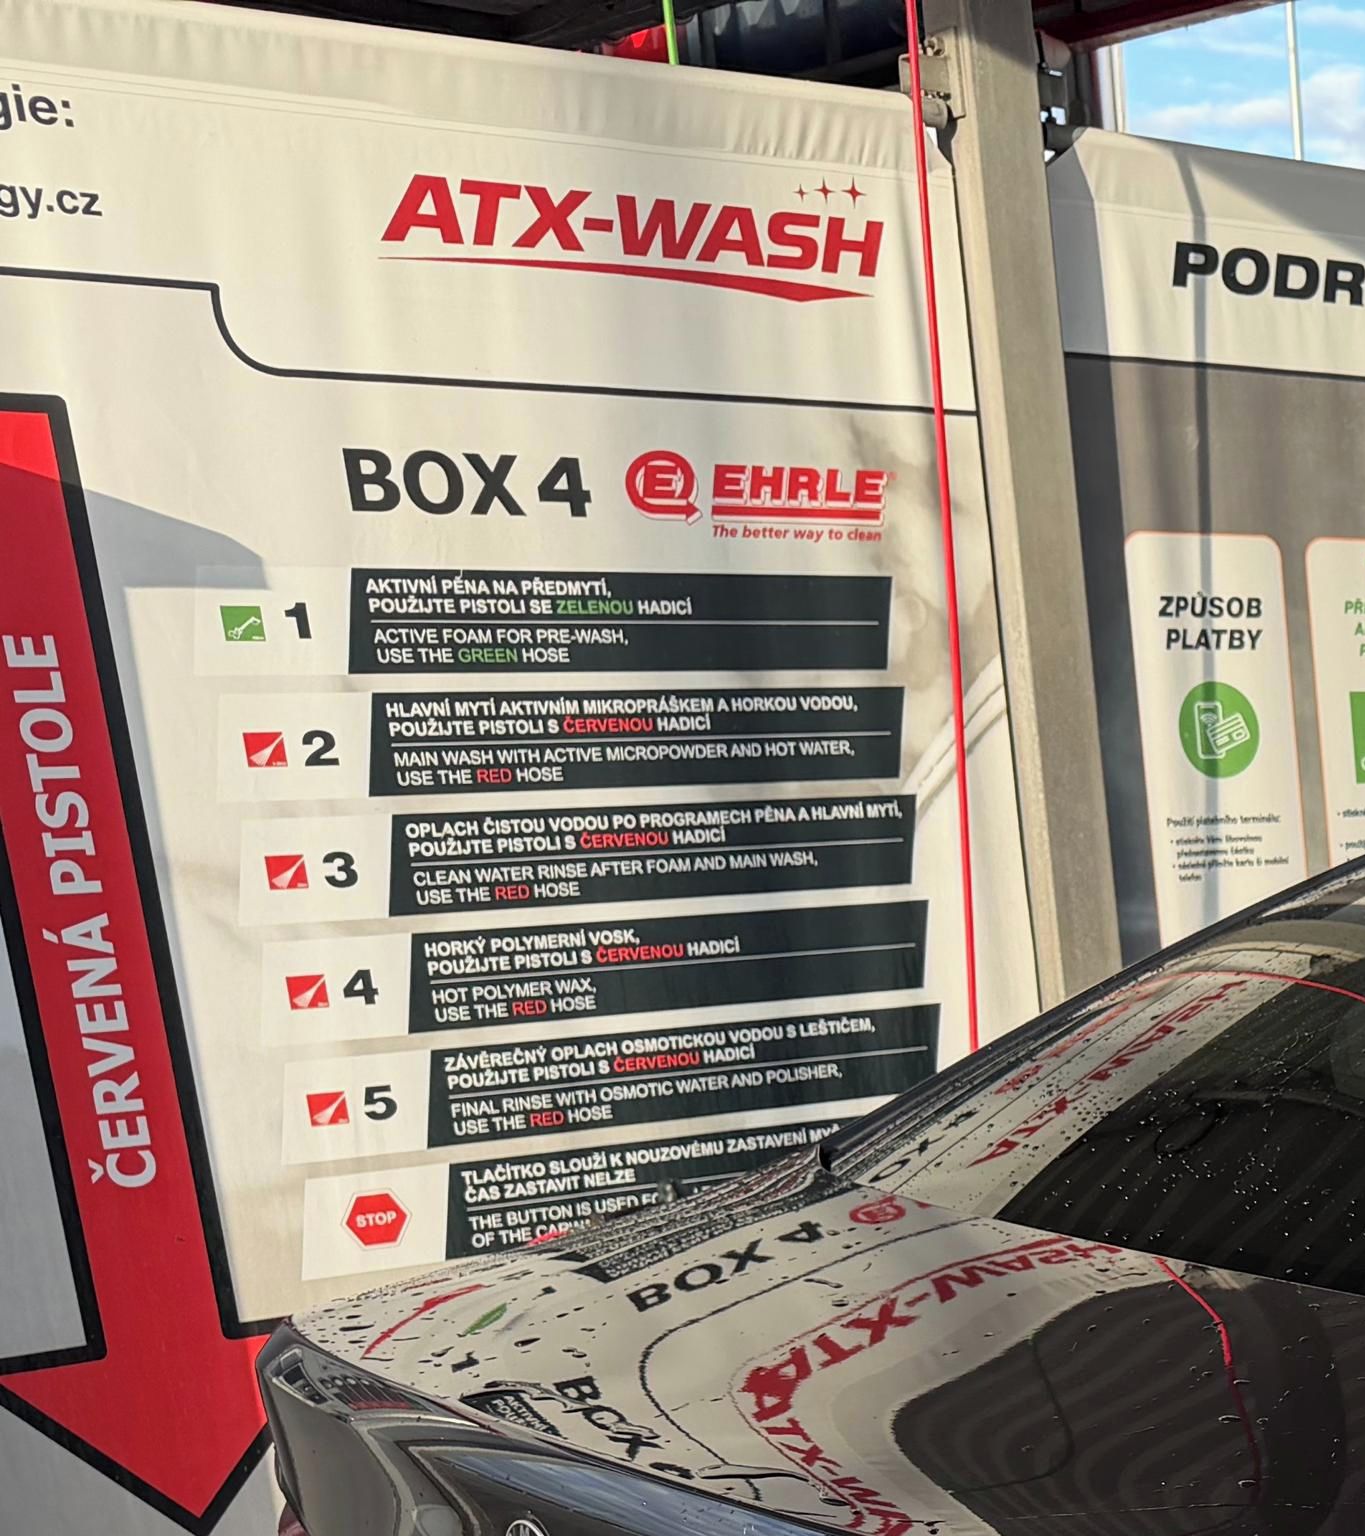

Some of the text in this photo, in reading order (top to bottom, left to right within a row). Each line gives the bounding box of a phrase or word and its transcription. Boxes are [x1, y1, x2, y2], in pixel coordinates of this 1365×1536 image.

[381, 174, 884, 278] ATX-WASH
[342, 448, 592, 517] BOX 4
[712, 464, 888, 508] EHRLE
[712, 524, 881, 542] The better way to clean
[366, 576, 611, 598] AKTIVNÍ PĚNA NA PŘEDMYTÍ,
[369, 595, 692, 615] POUŽIJTE PISTOLI SE ZELENOU HADICÍ
[1158, 591, 1262, 618] ZPŮSOB
[284, 602, 312, 640] 1
[374, 629, 629, 646] ACTIVE FOAM FOR PRE-WASH,
[1166, 629, 1263, 650] PLATBY
[377, 649, 570, 663] USE THE GREEN HOSE
[386, 695, 858, 717] HLAVNÍ MYTÍ AKTIVNÍM MIKROPRÁŠKEM HORKOU VODOU,
[389, 714, 710, 736] POUŽIJTE PISTOLI ČERVENOU HADICÍ
[302, 730, 340, 766] 2
[394, 740, 854, 767] MAIN WASH WITH ACTIVE MICROPOWDER AND HOT WATER,
[397, 767, 563, 786] USE THE RED HOSE
[406, 800, 902, 838] OPLACH ČISTOU VODOU PO PROGRAMECH PĚNA HLAVNÍ MYTÍ,
[322, 852, 358, 888] 3
[414, 851, 818, 886] CLEAN WATER RINSE AFTER FOAM AND MAIN WASH,
[3, 635, 157, 1189] ČERVENÁ PISTOLE
[425, 928, 639, 957] HORKÝ POLYMERNÍ VOSK,
[428, 936, 740, 976] POUŽIJTE PISTOLI ČERVENOU HADICÍ
[343, 969, 379, 1005] 4
[432, 978, 596, 1004] HOT POLYMER WAX,
[444, 1018, 875, 1072] ZÁVĚREČNÝ OPLACH OSMOTICKOU VODOU LEŠTIČEM,
[364, 1085, 397, 1121] 5
[451, 1063, 842, 1118] FINAL RINSE WITH OSMOTIC WATER AND POLISHER,
[454, 1105, 613, 1136] USE THE RED HOSE
[461, 1127, 806, 1185] TLAČÍTKO SLOUŽÍ K NOUZOVÉMU ZASTAVENÍ
[465, 1168, 636, 1203] ČAS ZASTAVIT NELZE
[355, 1210, 397, 1228] STOP
[469, 1214, 502, 1231] THE
[507, 1205, 573, 1226] BUTTON
[577, 1201, 591, 1216] IS
[472, 1227, 532, 1248] OF THE
